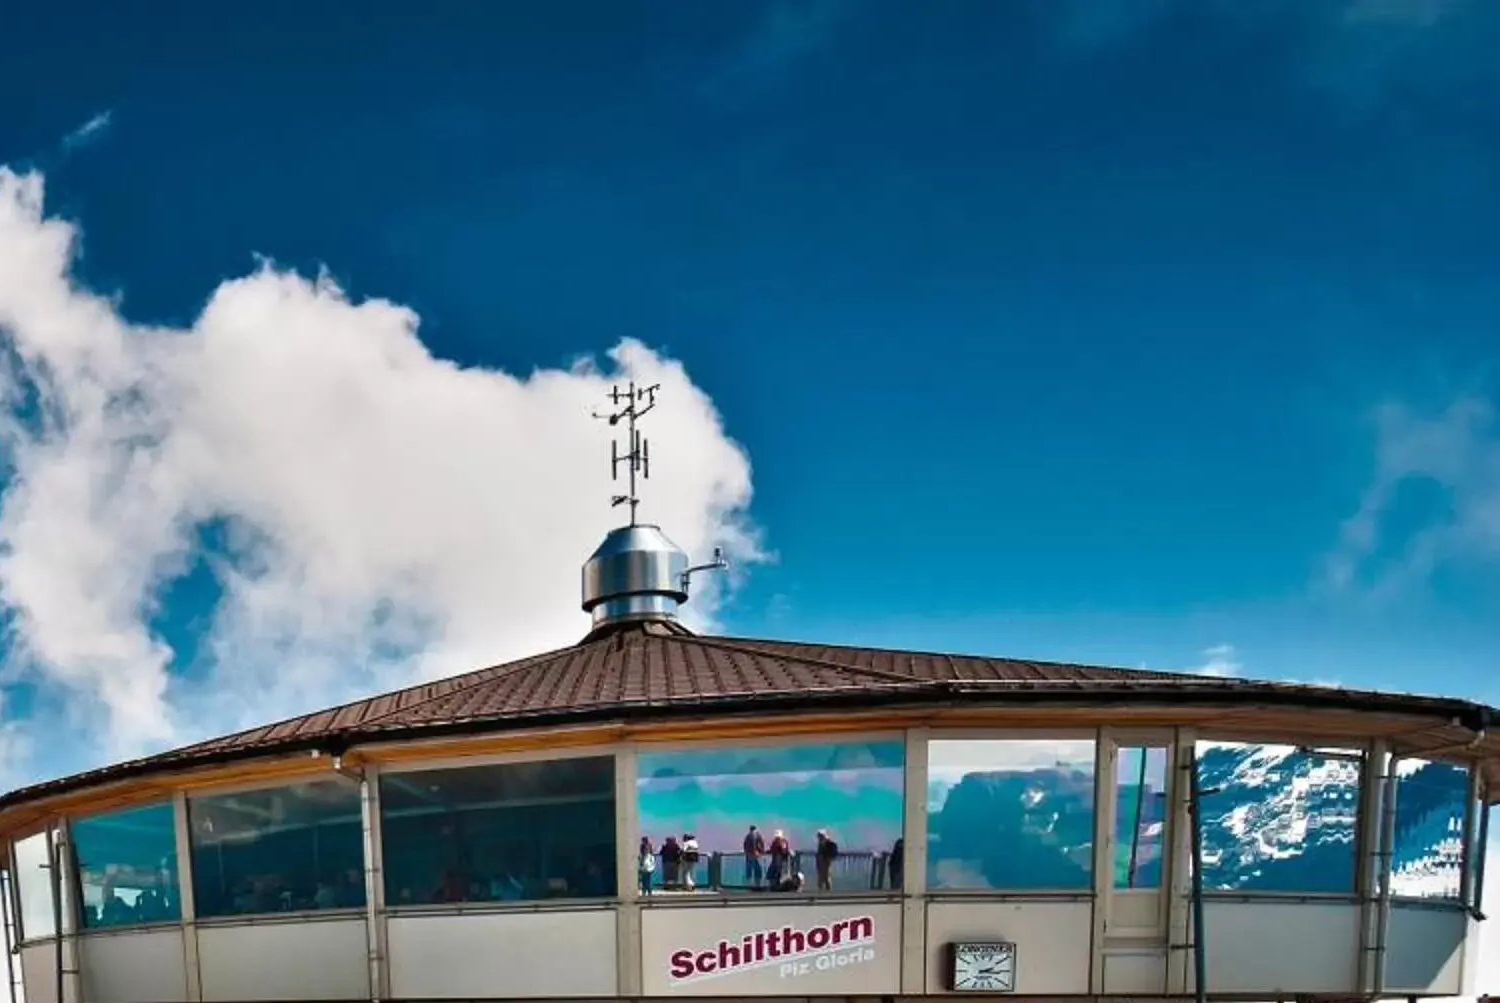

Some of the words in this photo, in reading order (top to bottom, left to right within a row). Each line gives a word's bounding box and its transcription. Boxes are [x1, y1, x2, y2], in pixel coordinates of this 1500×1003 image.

[670, 917, 873, 978] Schilthorn
[780, 961, 811, 978] Piz
[816, 948, 875, 970] Gloria
